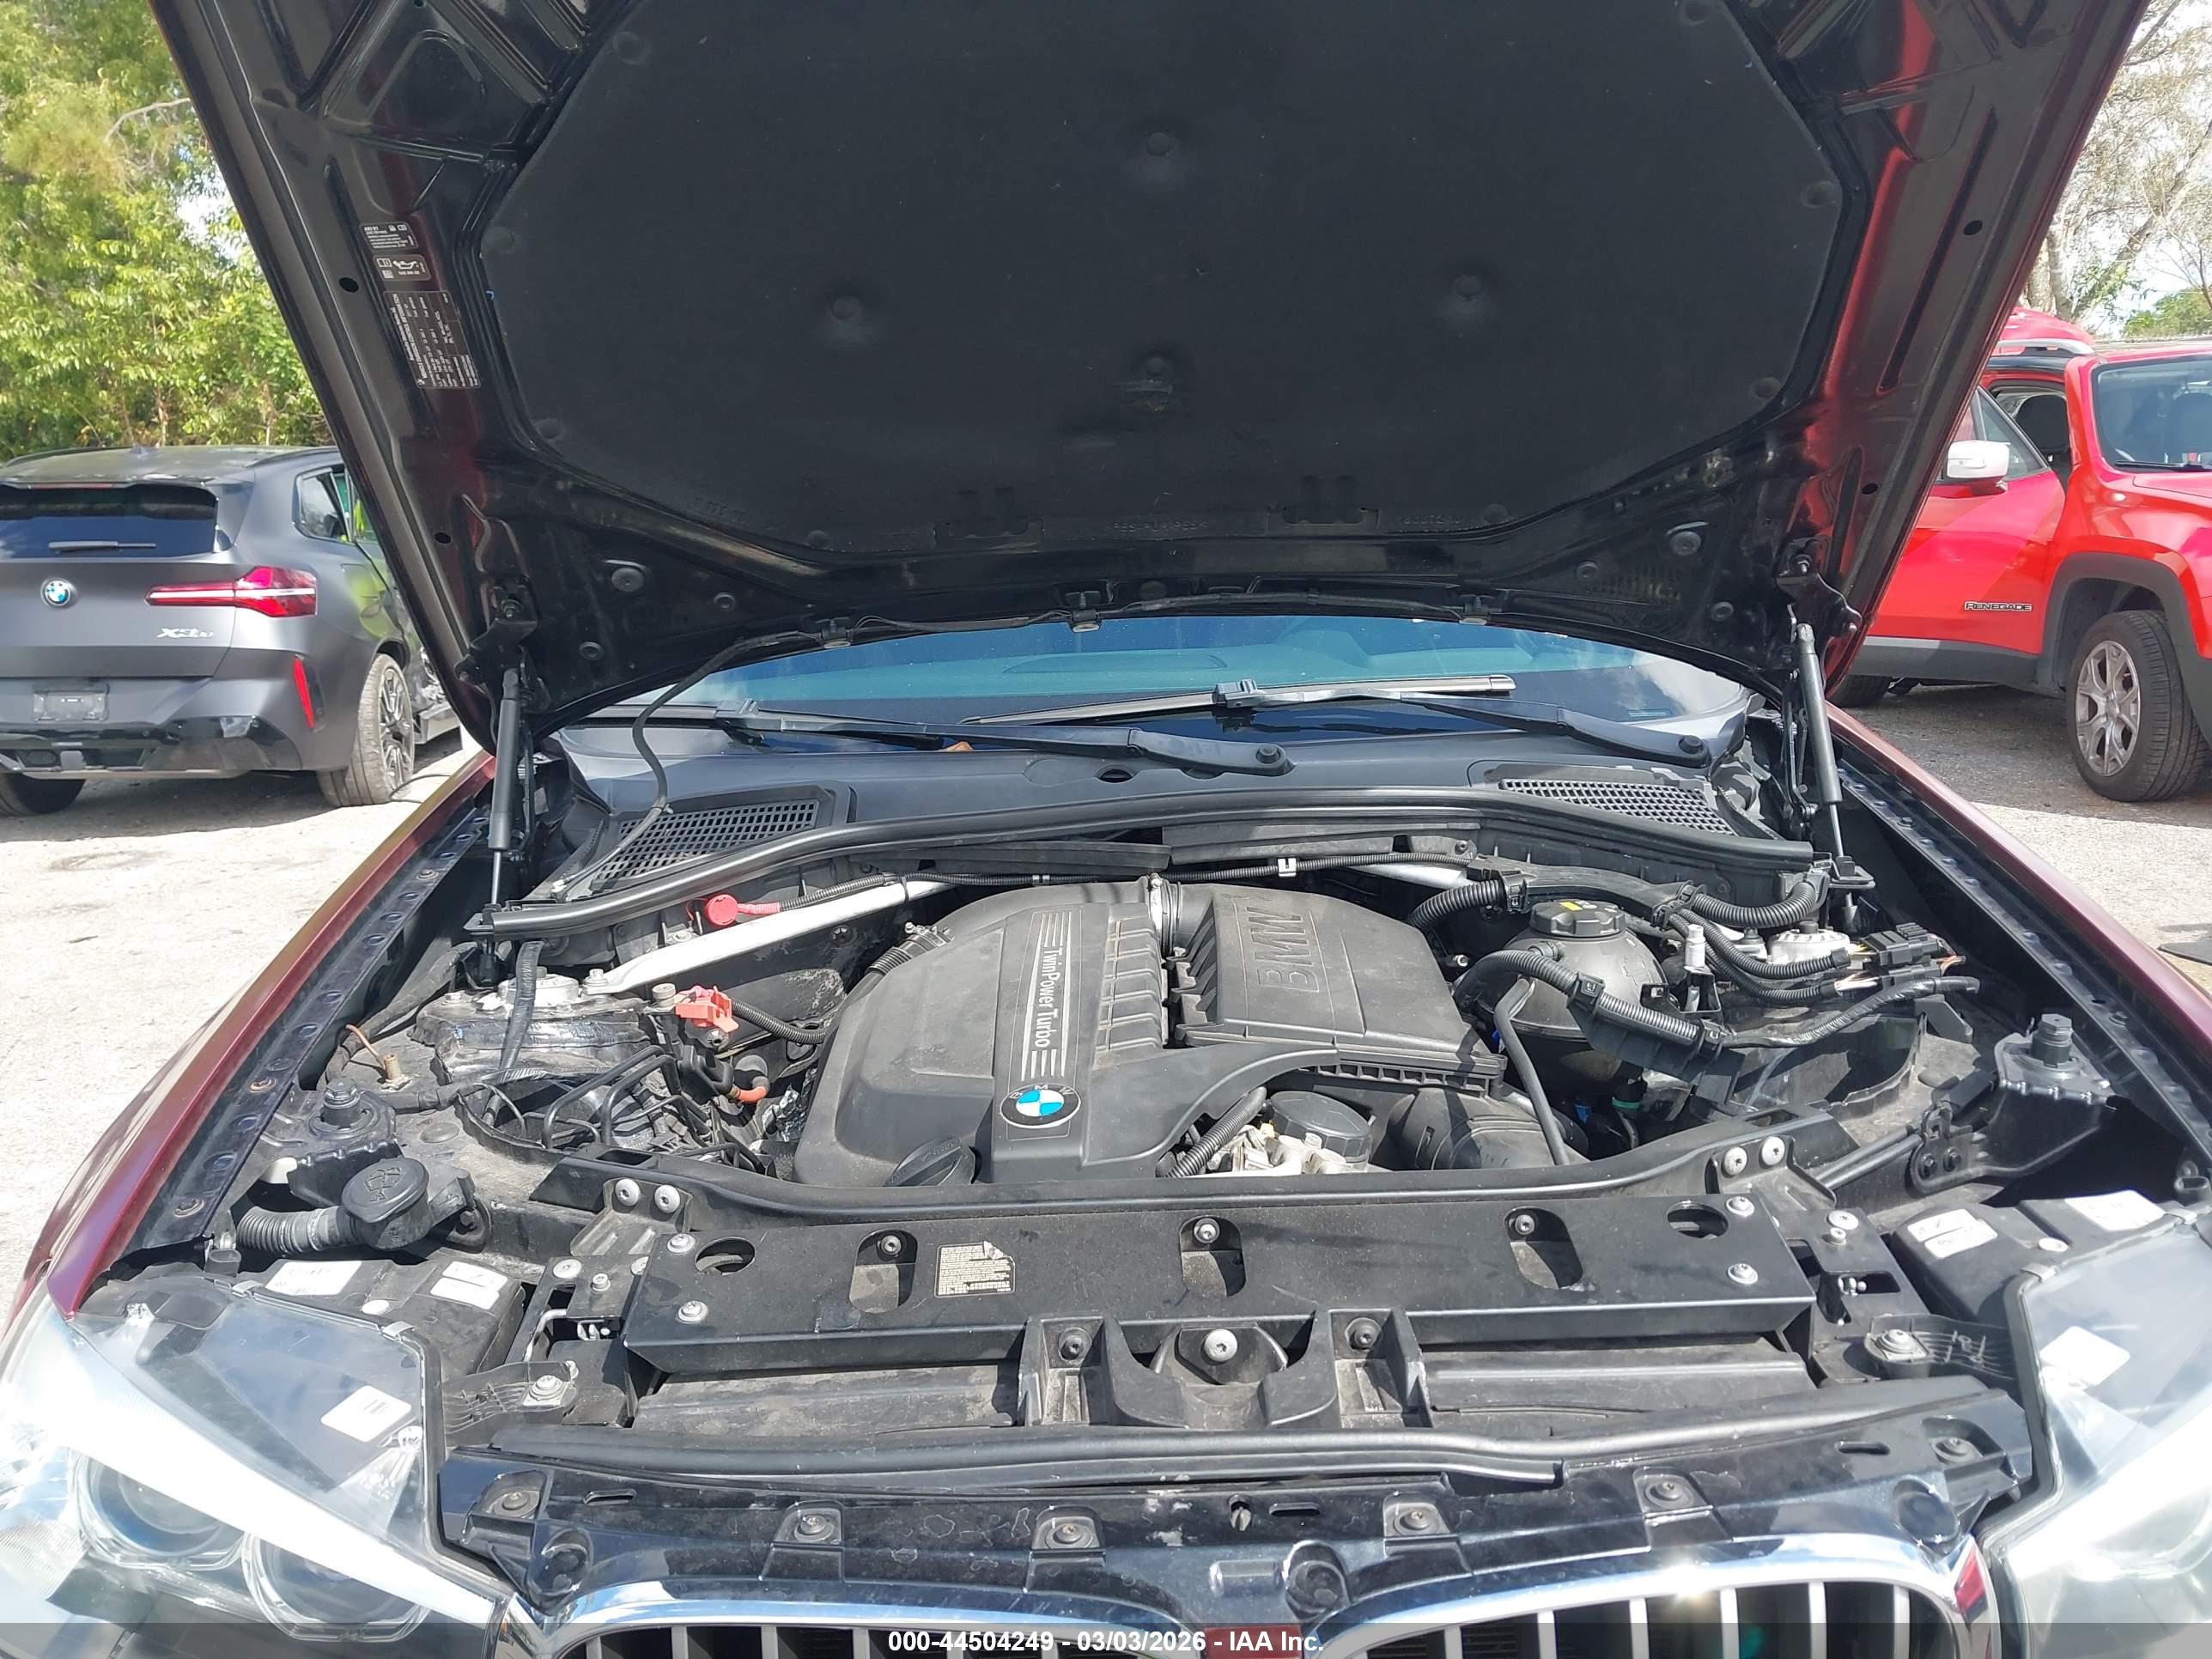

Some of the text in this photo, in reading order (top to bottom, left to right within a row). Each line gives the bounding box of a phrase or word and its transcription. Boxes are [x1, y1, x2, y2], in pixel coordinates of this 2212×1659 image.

[1244, 906, 1319, 993] BMW
[1034, 946, 1063, 1048] TwinPower Turbo
[1009, 1084, 1075, 1099] BMW
